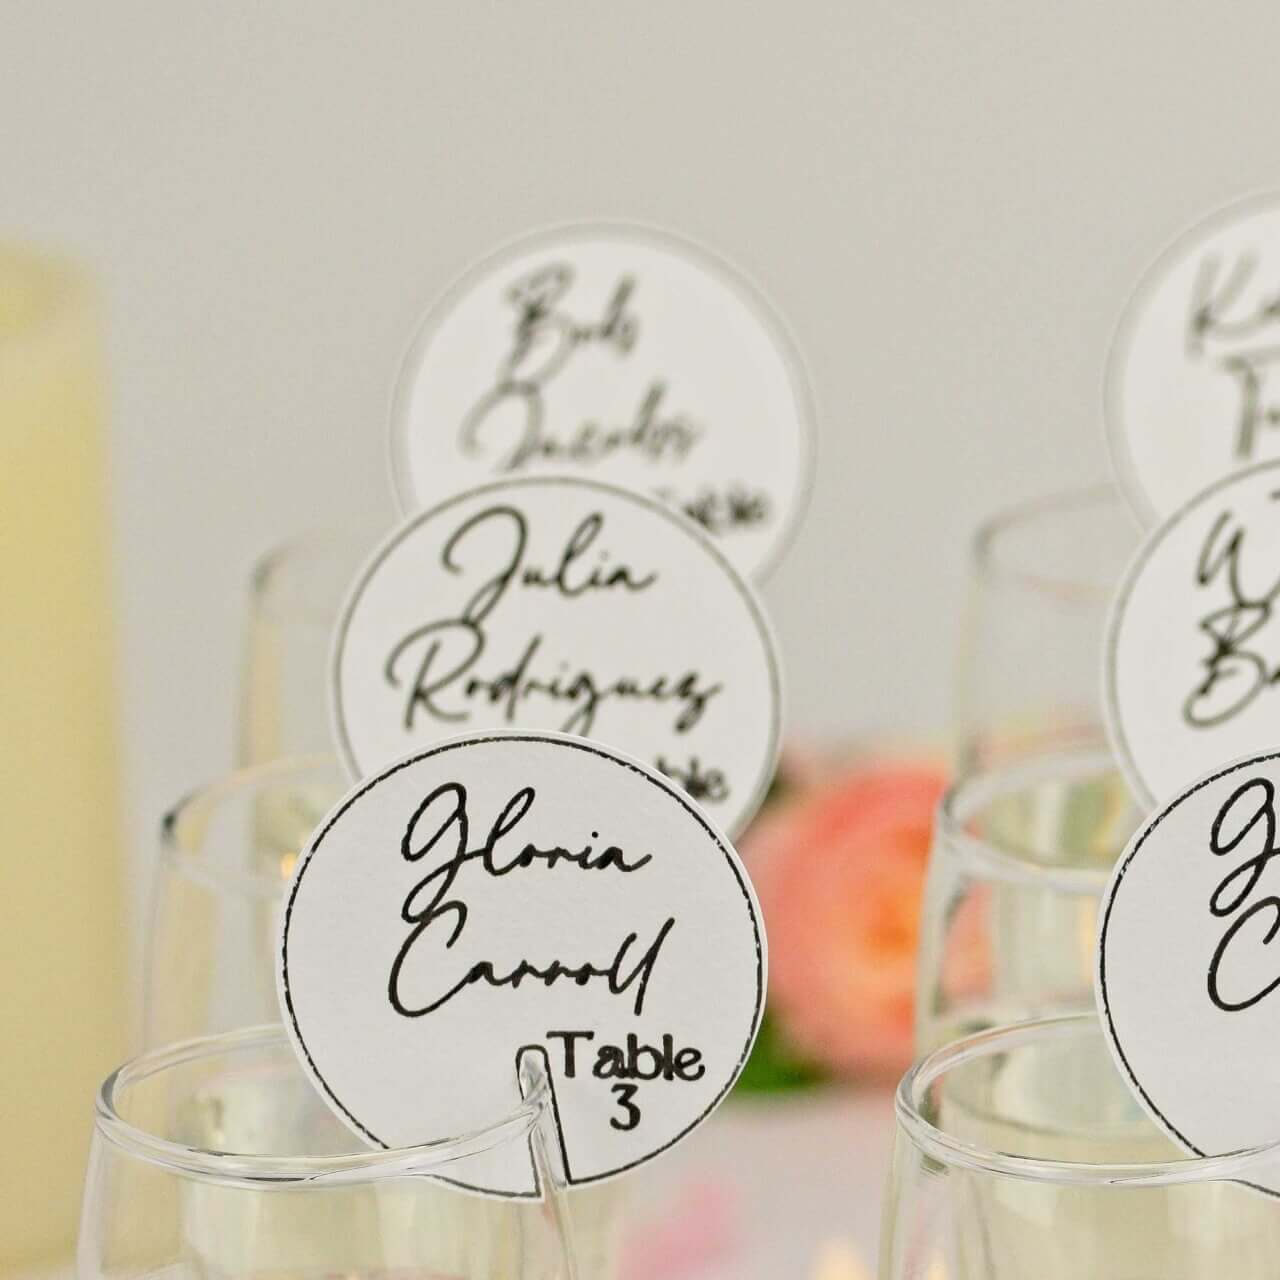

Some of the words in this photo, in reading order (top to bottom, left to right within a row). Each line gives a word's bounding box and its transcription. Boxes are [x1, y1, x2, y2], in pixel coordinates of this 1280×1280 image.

[442, 505, 657, 624] Julia
[386, 617, 724, 738] Rodriguez
[401, 782, 653, 924] Gloria
[388, 900, 676, 1018] Carroll
[546, 1030, 706, 1082] Table
[609, 1083, 642, 1131] 3
